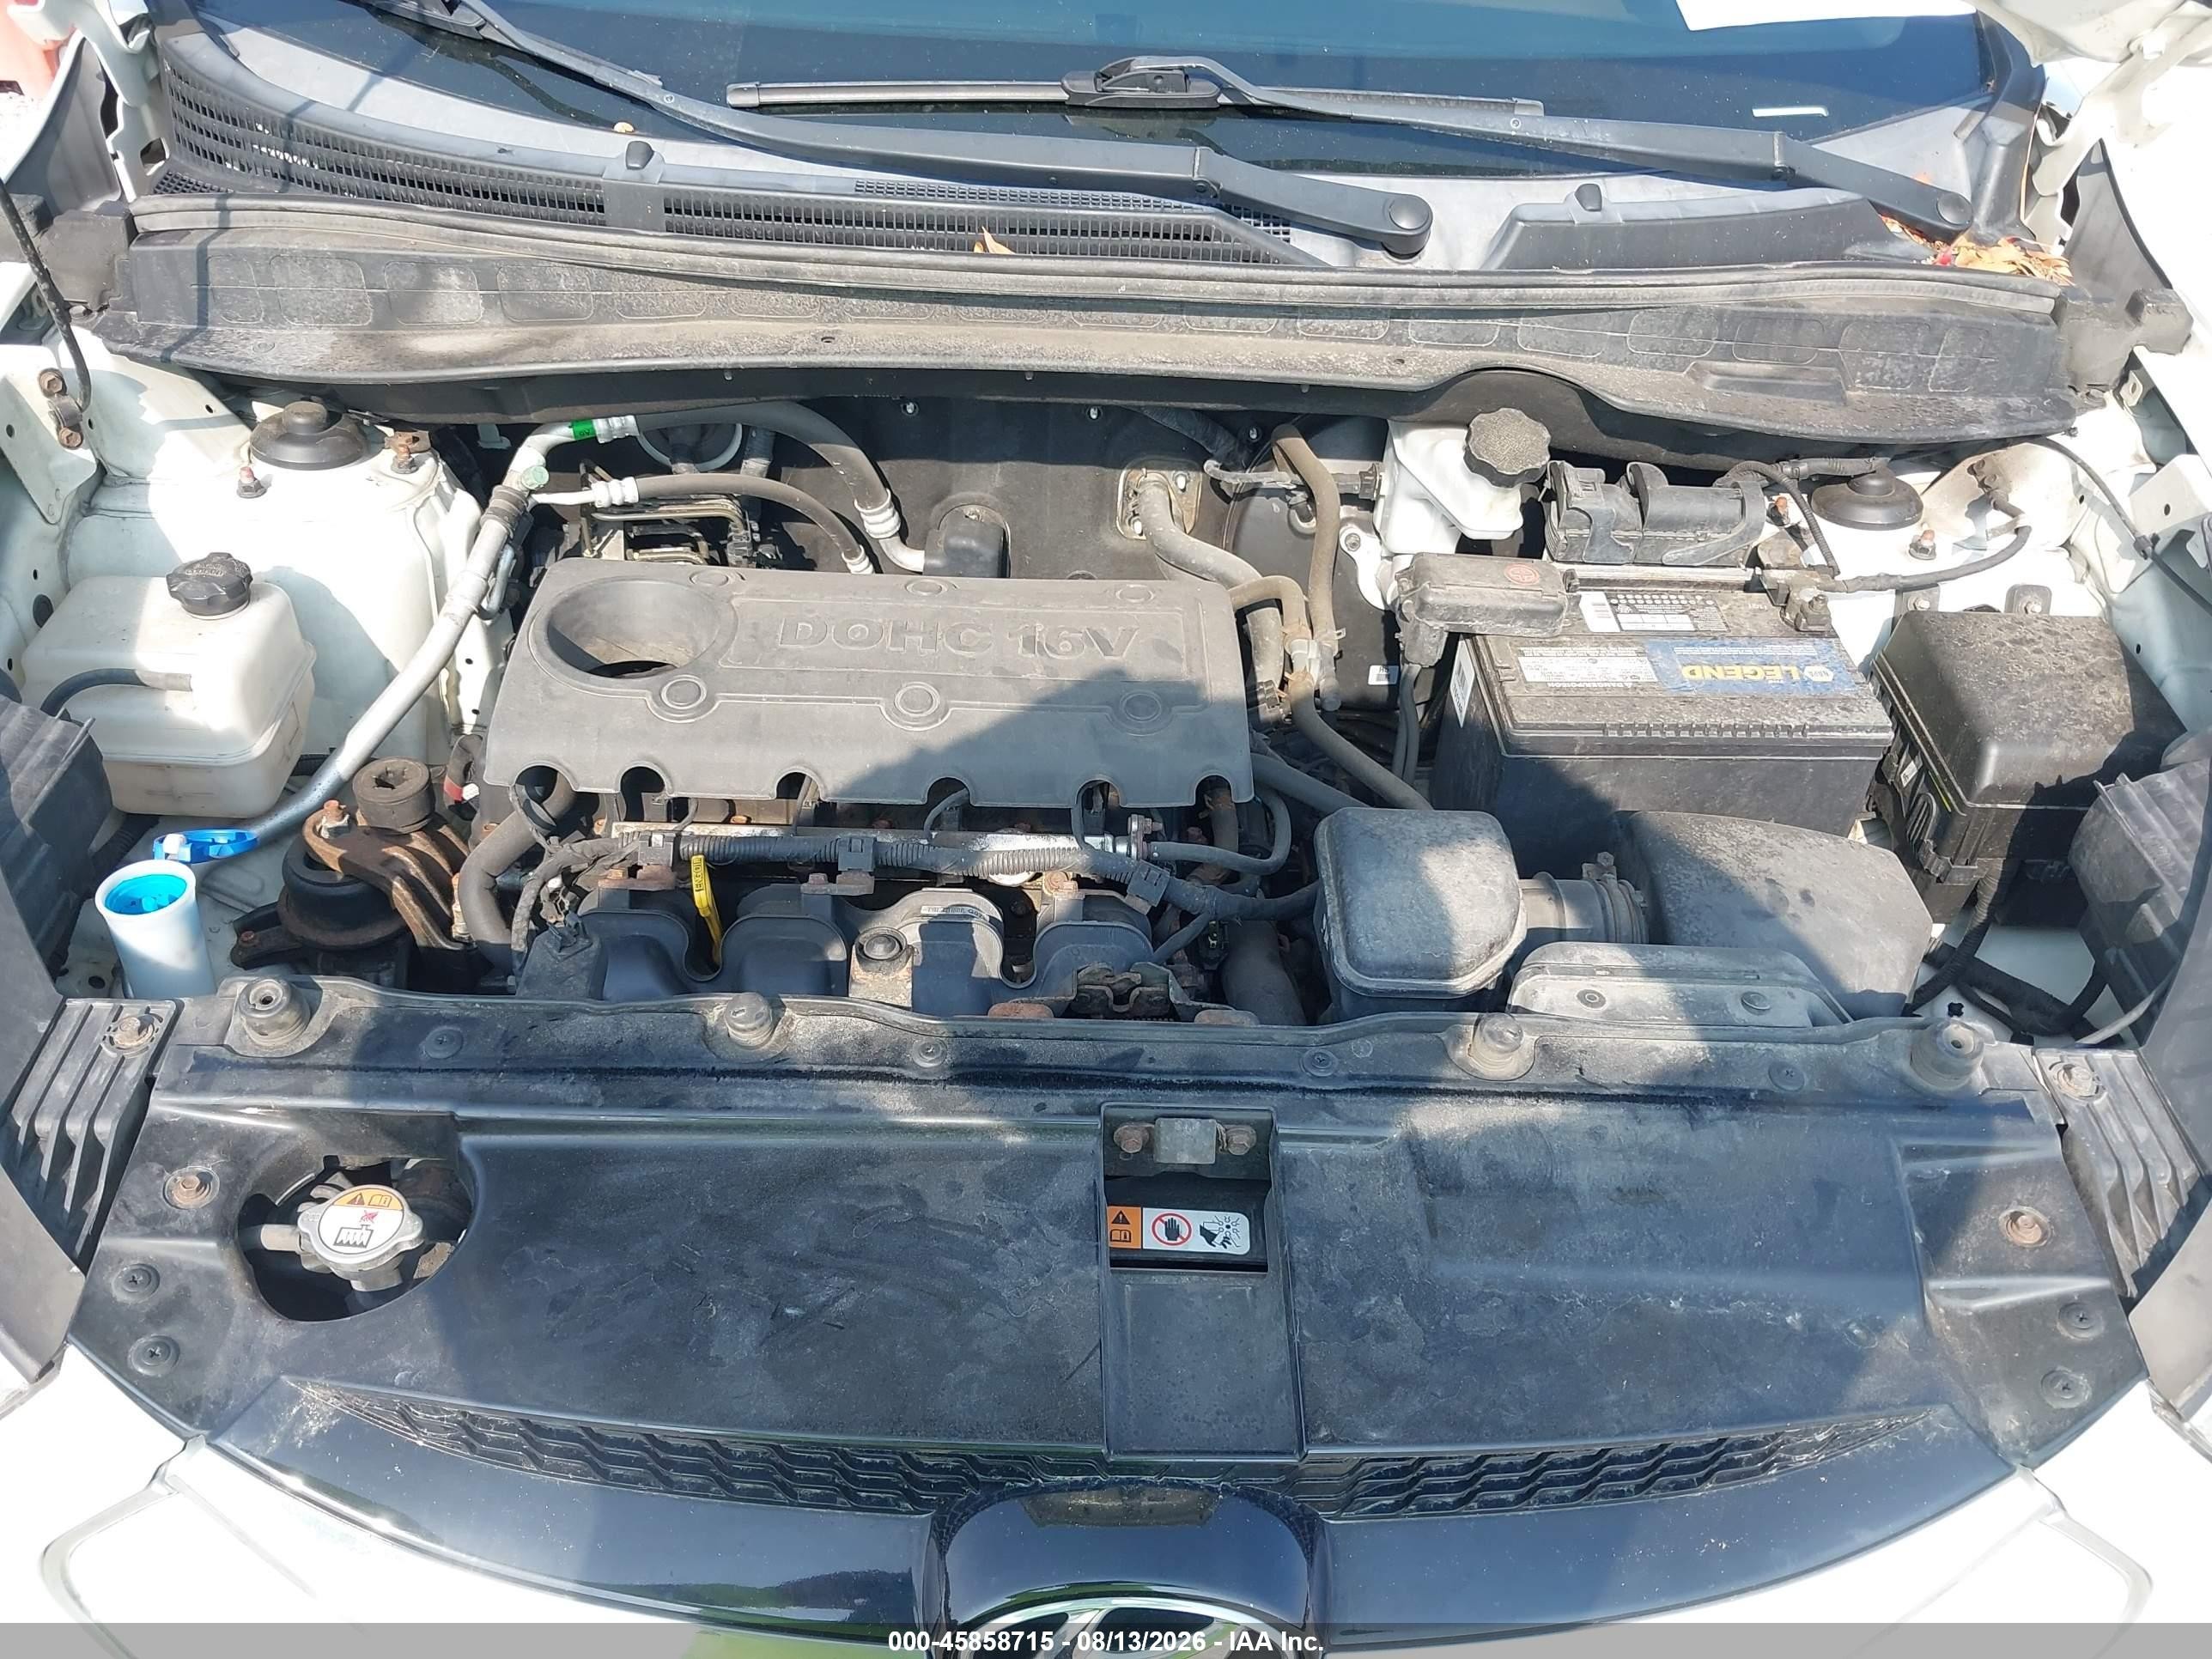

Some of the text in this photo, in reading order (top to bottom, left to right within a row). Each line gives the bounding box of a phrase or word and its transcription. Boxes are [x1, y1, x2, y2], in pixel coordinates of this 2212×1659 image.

[778, 616, 1140, 661] DOHC 16V
[1680, 665, 1802, 681] LEGEND
